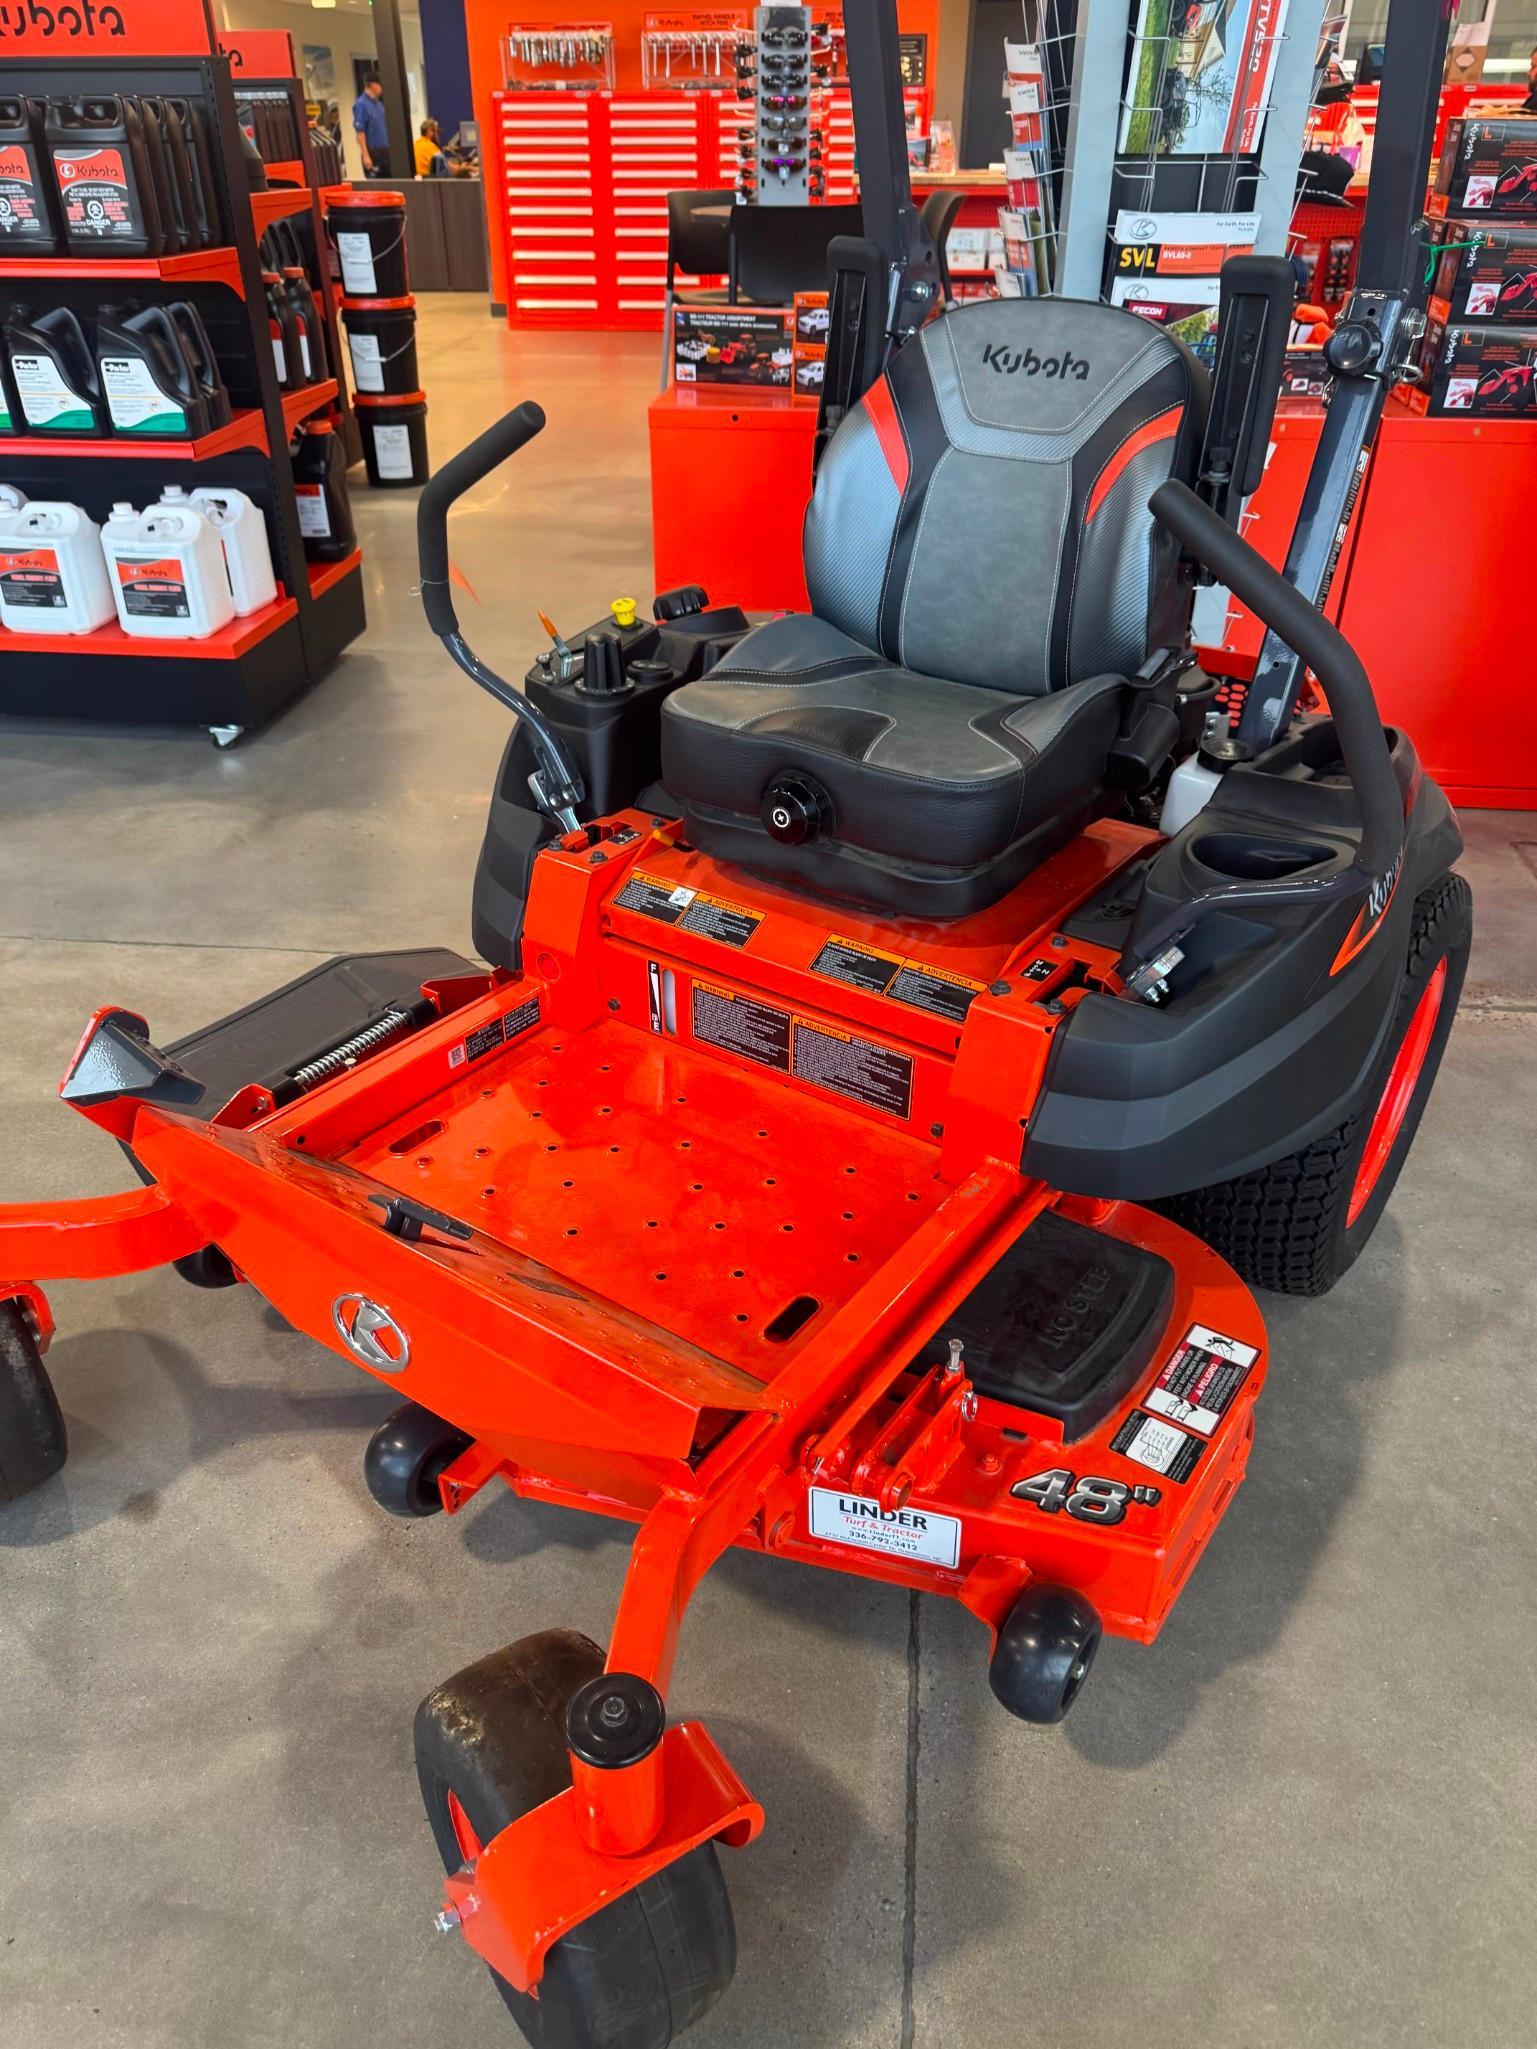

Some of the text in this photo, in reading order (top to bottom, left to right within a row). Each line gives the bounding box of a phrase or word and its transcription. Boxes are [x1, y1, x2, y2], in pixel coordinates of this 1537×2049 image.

[0, 0, 126, 36] ubota
[1464, 123, 1480, 160] Kubota
[76, 165, 118, 177] Kubota
[1119, 247, 1156, 268] SVL
[1132, 305, 1163, 316] FECON
[1444, 329, 1460, 364] Kubota
[982, 343, 1090, 381] Kubota
[714, 899, 753, 916] ADVERTENCIA
[845, 941, 874, 954] WARNING
[925, 966, 972, 987] ADVERTENCIA
[1165, 1348, 1184, 1375] DANGER
[1197, 1361, 1218, 1390] PELIGRO
[1010, 1468, 1162, 1525] 48"
[839, 1499, 928, 1530] LINDER
[843, 1515, 924, 1540] Turf & Tractor
[849, 1530, 918, 1550] 336-792-3412
